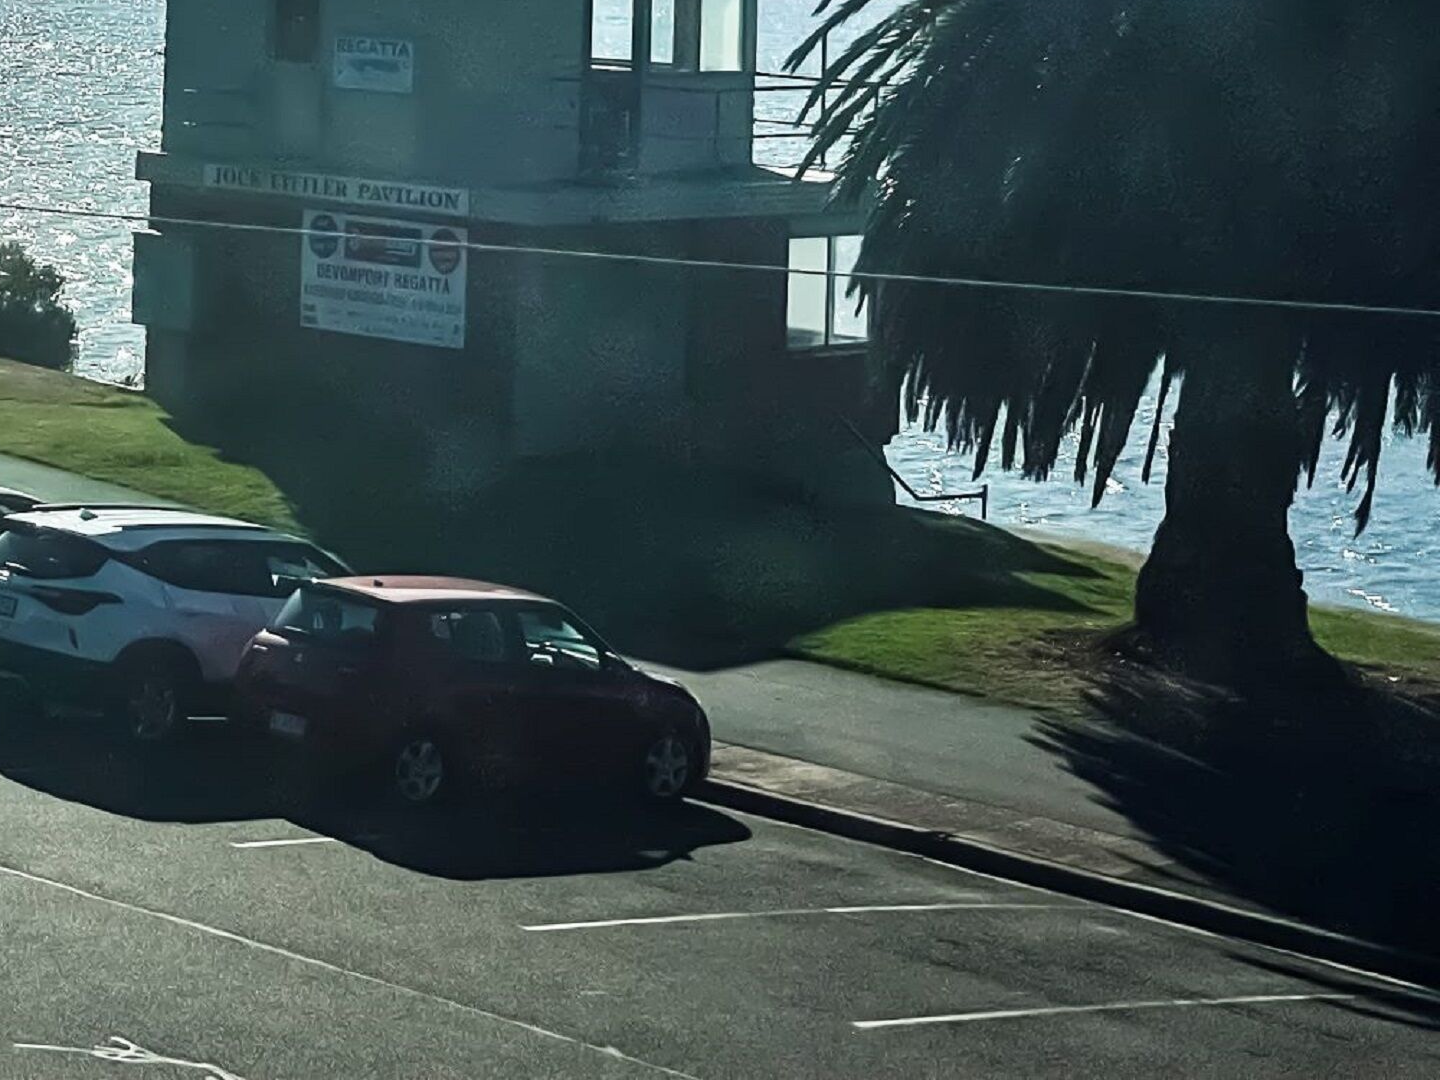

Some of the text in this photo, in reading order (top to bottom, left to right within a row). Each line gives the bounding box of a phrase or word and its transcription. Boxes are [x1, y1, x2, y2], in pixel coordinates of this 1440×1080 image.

[337, 37, 410, 57] REGATTA
[358, 182, 460, 210] PAVILION
[317, 262, 450, 295] DEVONPORT REGATTA
